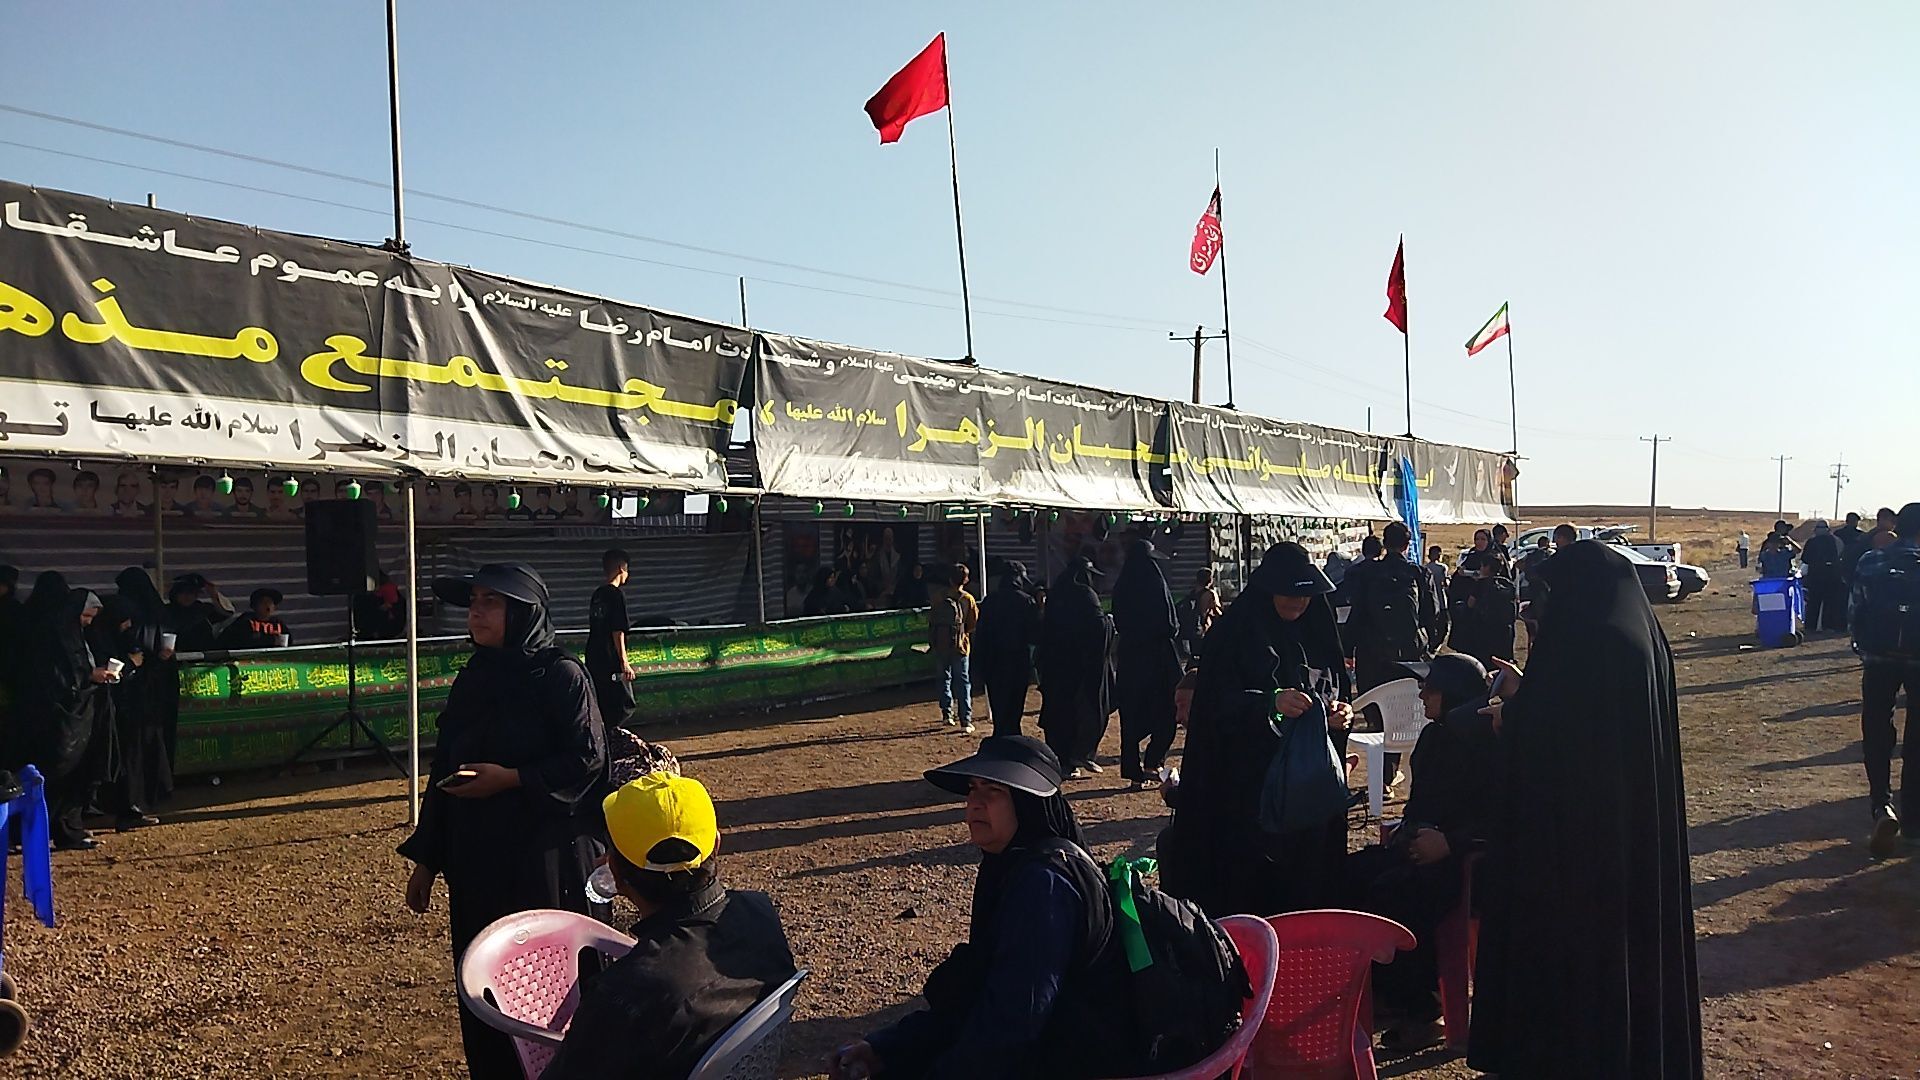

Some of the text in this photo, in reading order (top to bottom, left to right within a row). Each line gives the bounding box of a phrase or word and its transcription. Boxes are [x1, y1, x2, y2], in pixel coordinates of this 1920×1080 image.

[0, 202, 241, 265] عاشقا
[250, 252, 379, 287] عموم
[384, 276, 441, 306] به
[482, 290, 537, 311] السلام
[0, 277, 279, 363] مذه
[539, 303, 573, 318] علیه
[579, 309, 643, 345] رضا
[646, 326, 712, 353] امام
[823, 359, 836, 376] و
[840, 356, 873, 369] السلام
[874, 359, 894, 374] علیه
[300, 334, 738, 426] مجتمع
[893, 371, 957, 390] مجتبی
[958, 379, 1015, 395] حسن
[1016, 385, 1051, 402] امام
[786, 401, 823, 423] علیها
[826, 402, 853, 422] الله
[1053, 391, 1107, 412] شهادت
[89, 400, 172, 432] علیها
[180, 403, 222, 431] الله
[228, 411, 279, 438] سلام
[856, 408, 887, 428] سلام
[895, 400, 1045, 458] الزهرا
[288, 418, 456, 461] الزهرا
[1049, 423, 1187, 467] محبان
[466, 436, 575, 476] محبان
